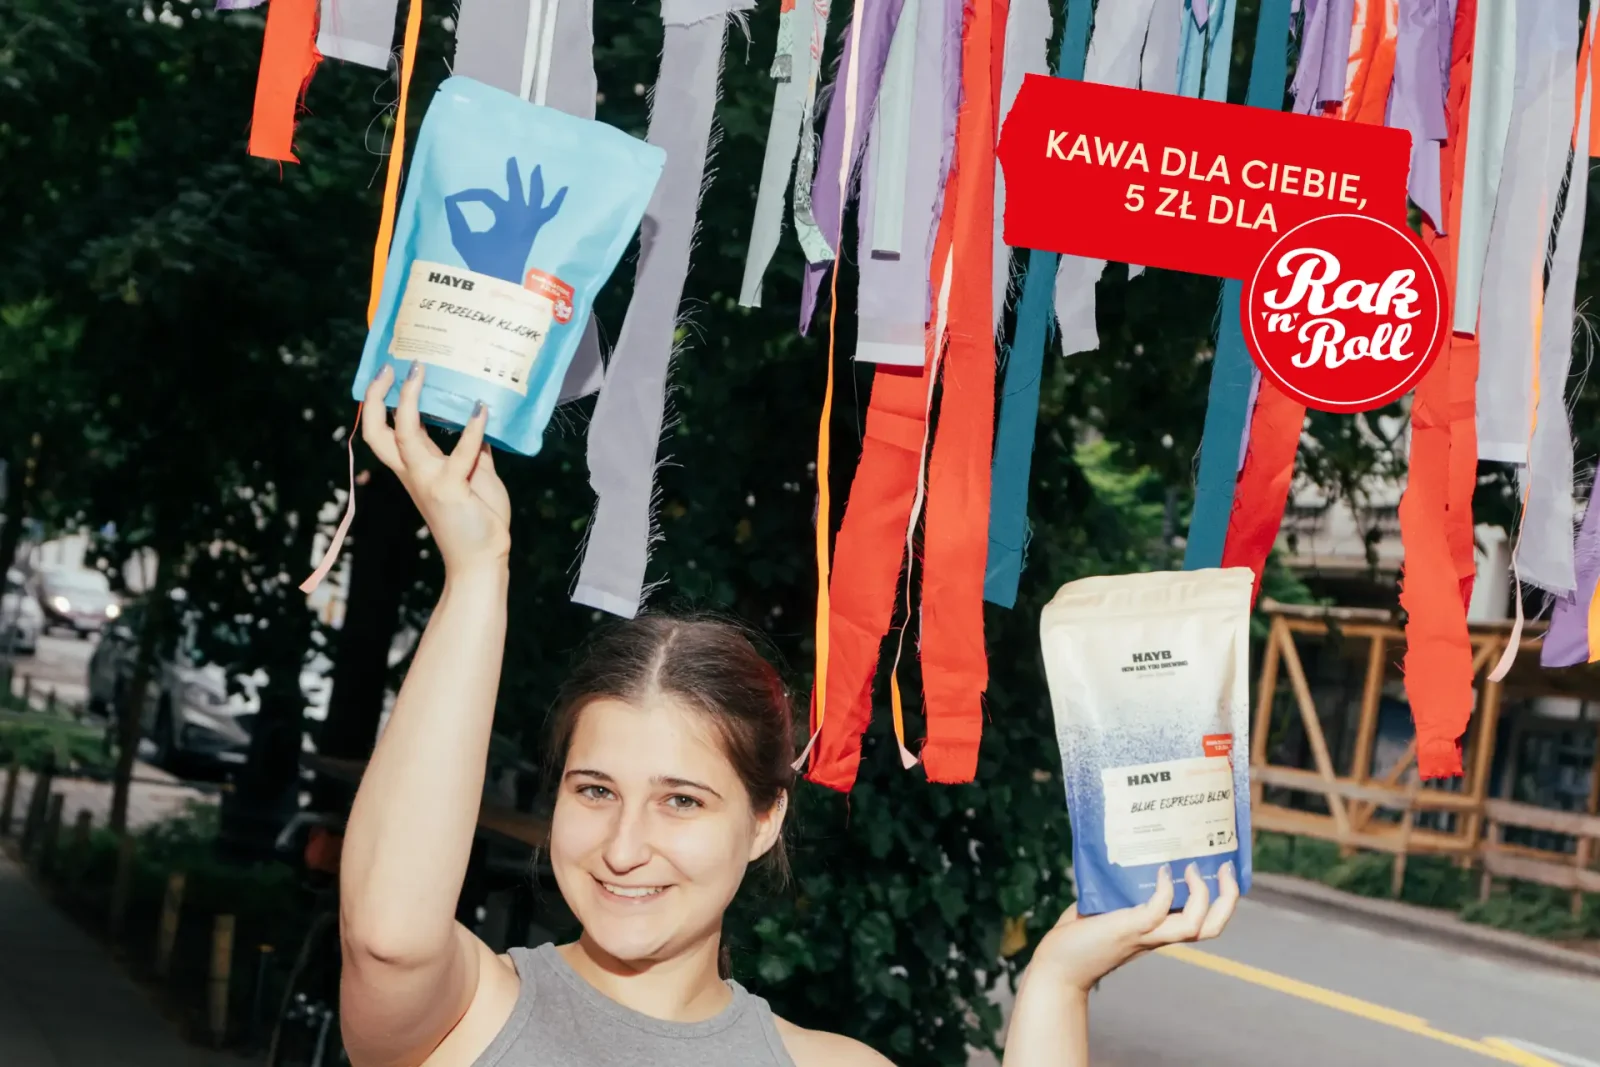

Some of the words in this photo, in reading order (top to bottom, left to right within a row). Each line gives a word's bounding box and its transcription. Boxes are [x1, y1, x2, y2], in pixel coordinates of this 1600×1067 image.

[428, 271, 476, 292] HAYB
[1132, 650, 1172, 663] HAYB
[1127, 771, 1172, 786] HAYB
[1130, 800, 1156, 813] BLUE
[1159, 792, 1206, 809] ESPRESSO
